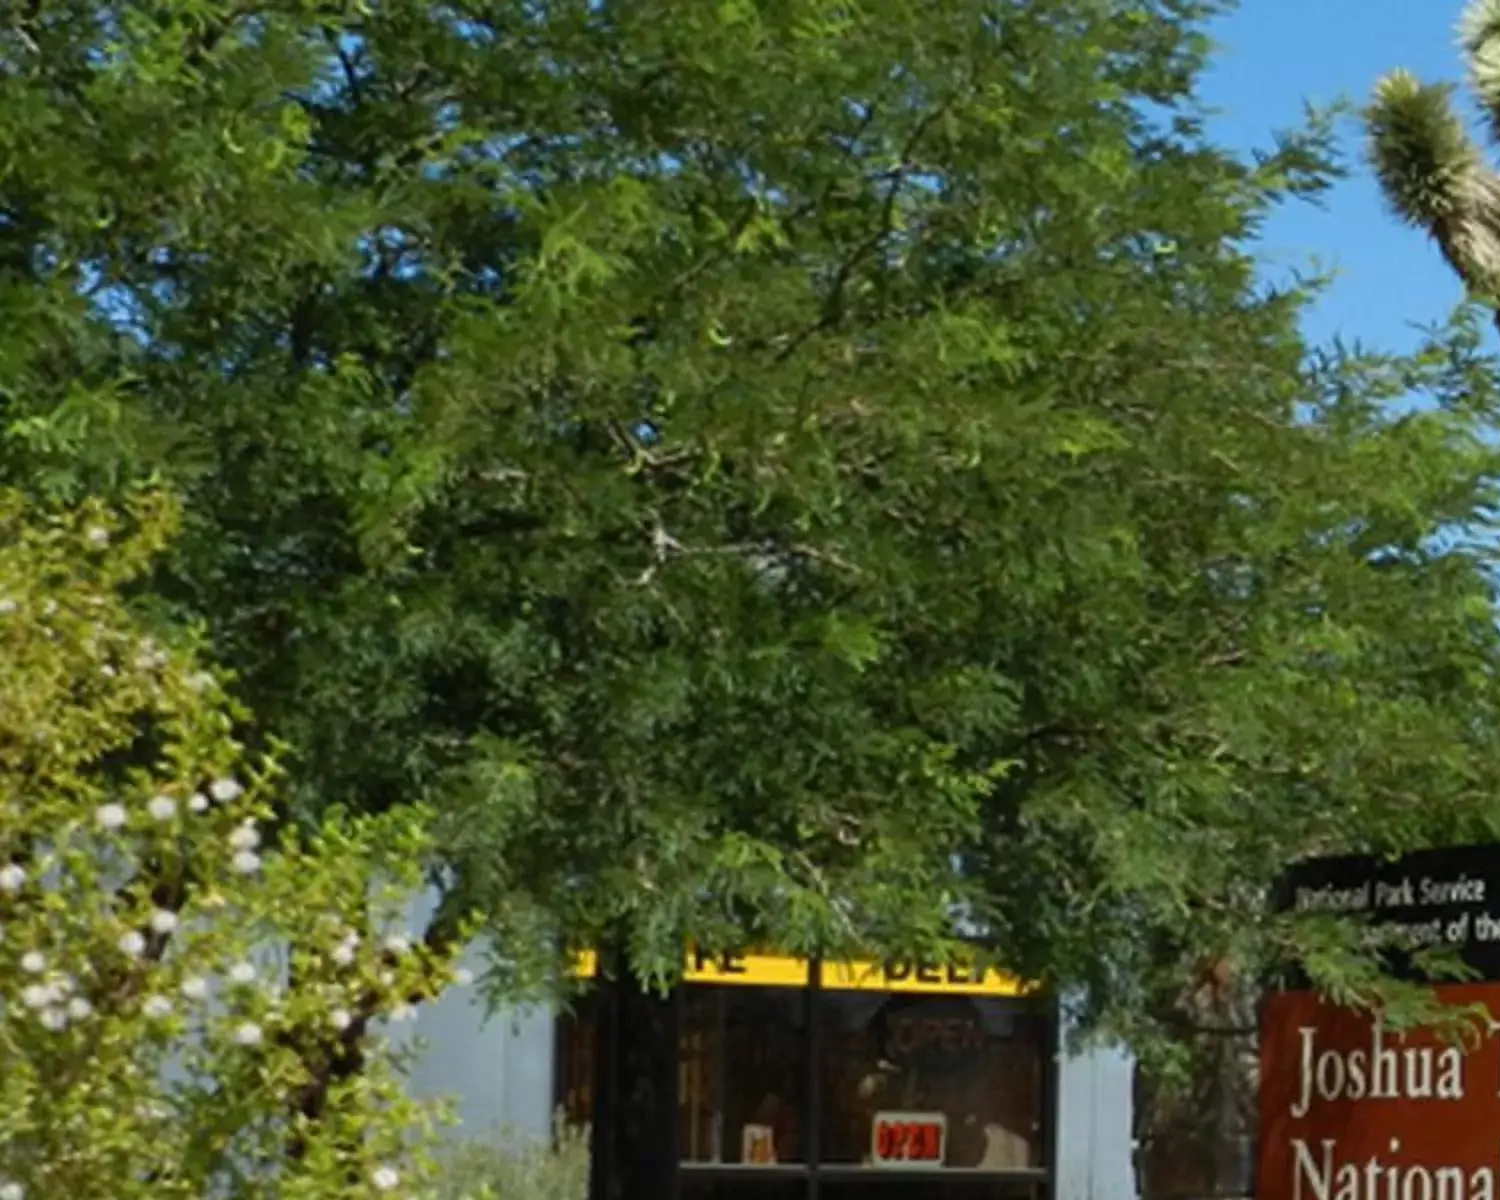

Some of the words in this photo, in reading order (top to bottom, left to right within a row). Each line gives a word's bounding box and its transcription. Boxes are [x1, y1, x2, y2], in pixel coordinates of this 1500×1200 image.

[1375, 876, 1414, 906] Park
[1418, 872, 1486, 904] Service
[1446, 911, 1469, 942] of
[1289, 1010, 1465, 1119] Joshua
